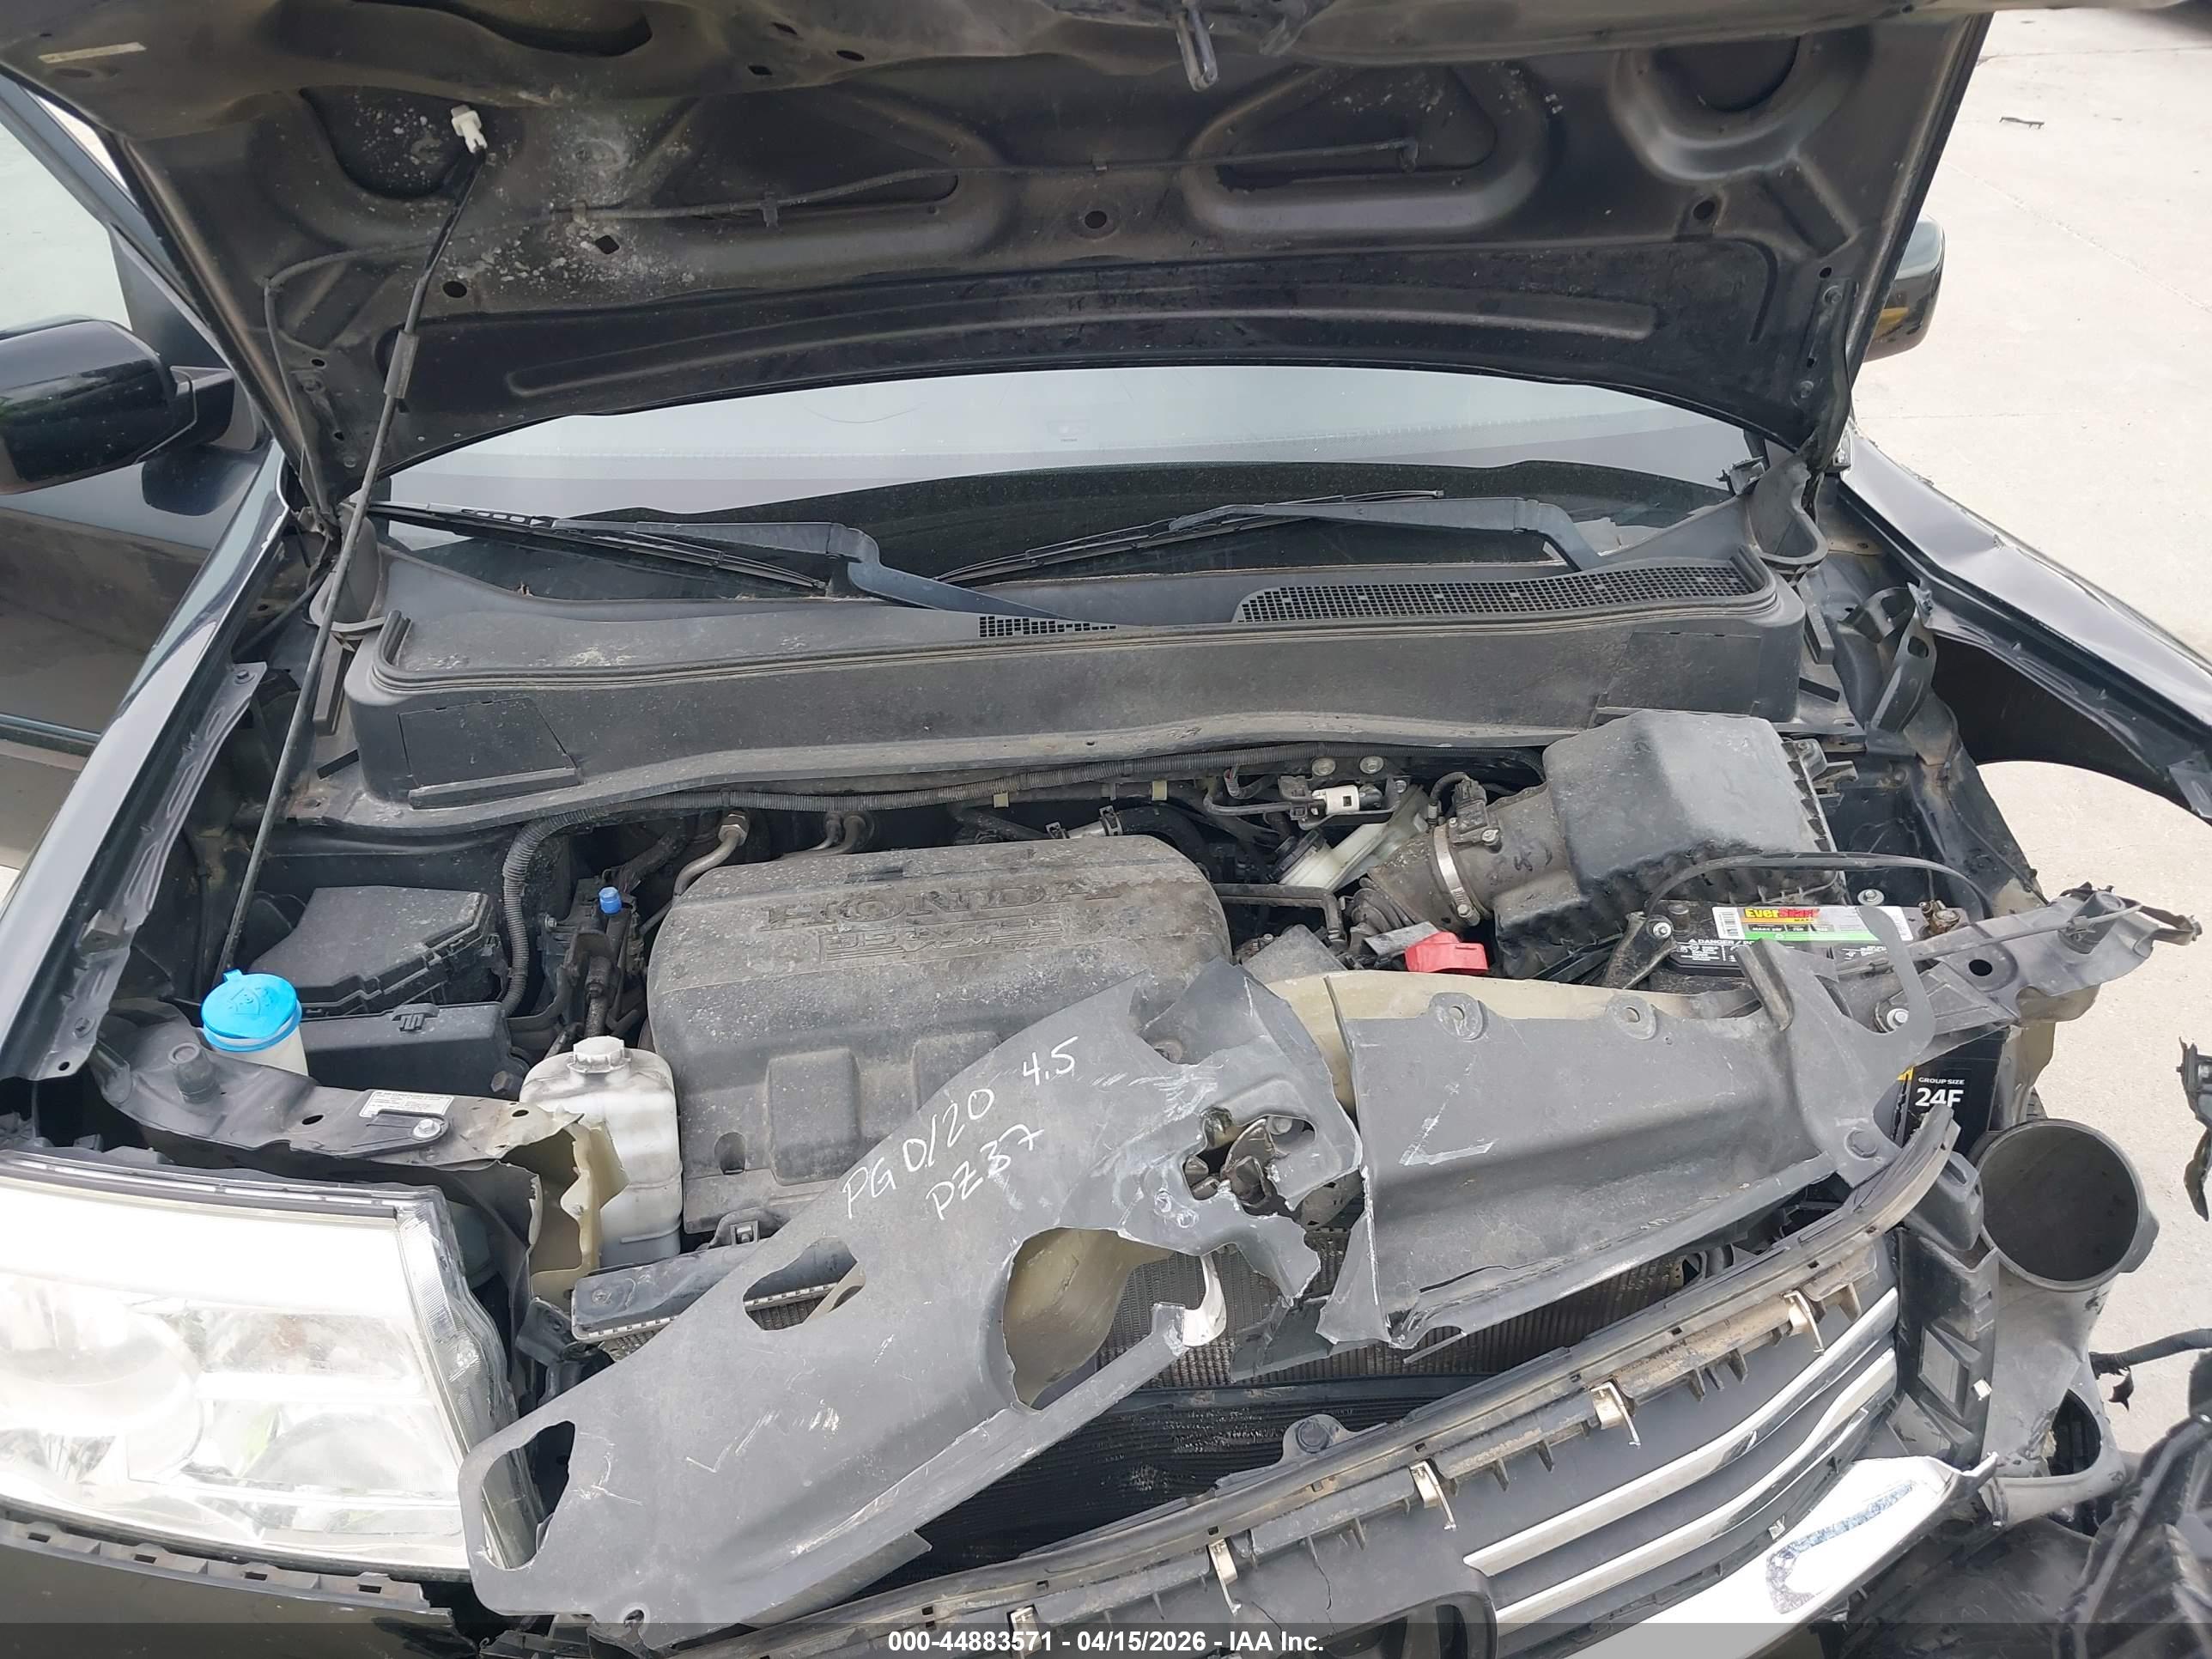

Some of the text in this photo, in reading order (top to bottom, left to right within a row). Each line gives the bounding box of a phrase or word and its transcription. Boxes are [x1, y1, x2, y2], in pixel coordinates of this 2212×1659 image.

[757, 878, 1121, 932] HONDA
[1023, 1036, 1079, 1086] 4.5
[1915, 1086, 1965, 1108] 24F
